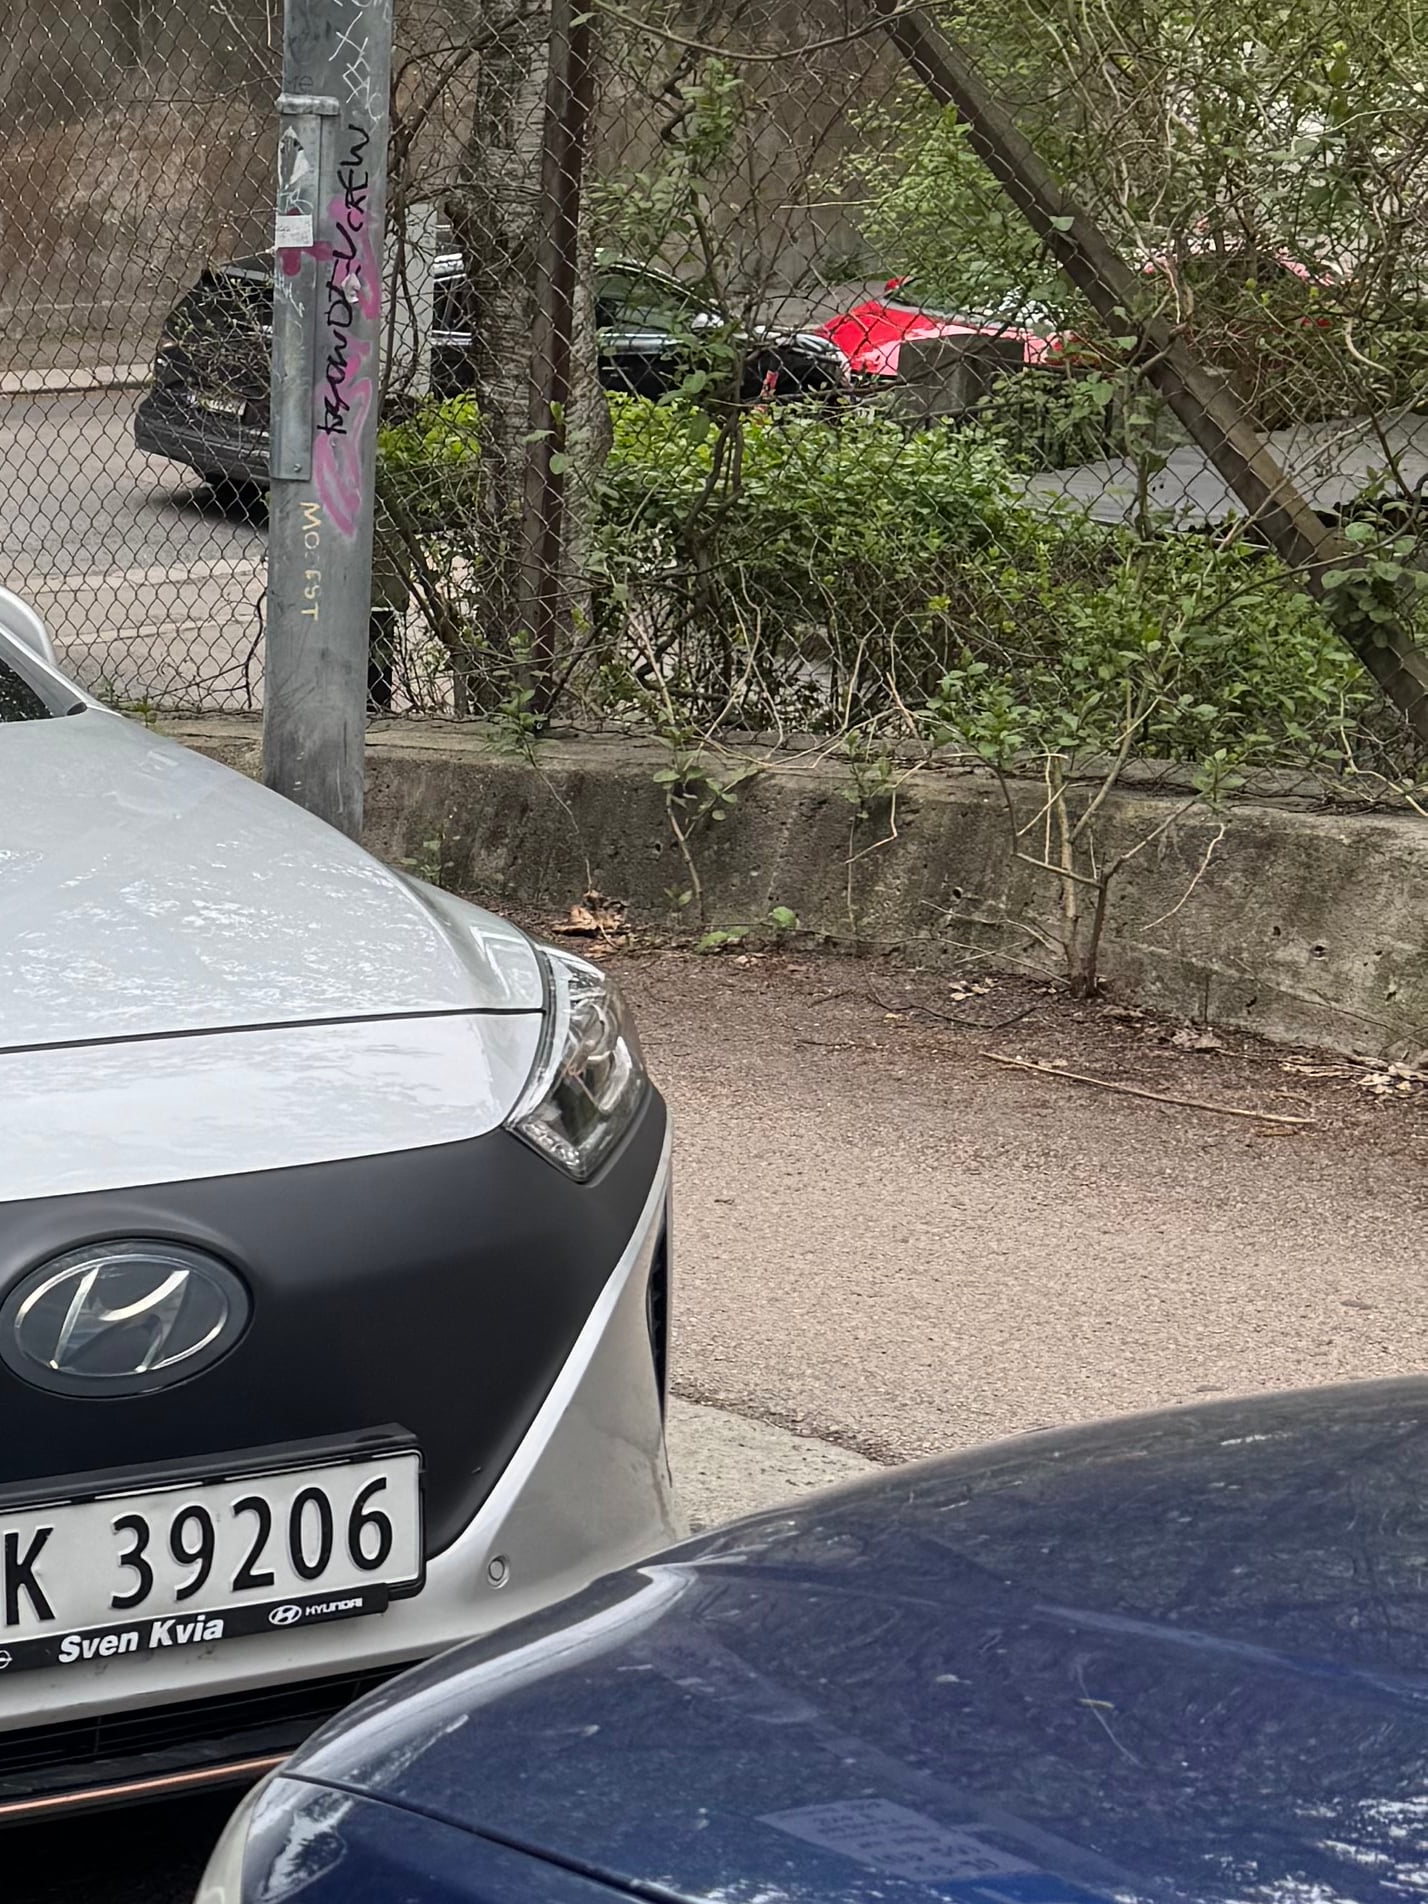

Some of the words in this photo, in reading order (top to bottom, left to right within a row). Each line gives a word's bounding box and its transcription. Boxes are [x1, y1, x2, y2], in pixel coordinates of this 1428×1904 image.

[109, 1476, 393, 1611] 39206
[58, 1631, 139, 1664] Sven
[148, 1615, 224, 1649] Kvia
[305, 1597, 362, 1617] HYUNDAI
